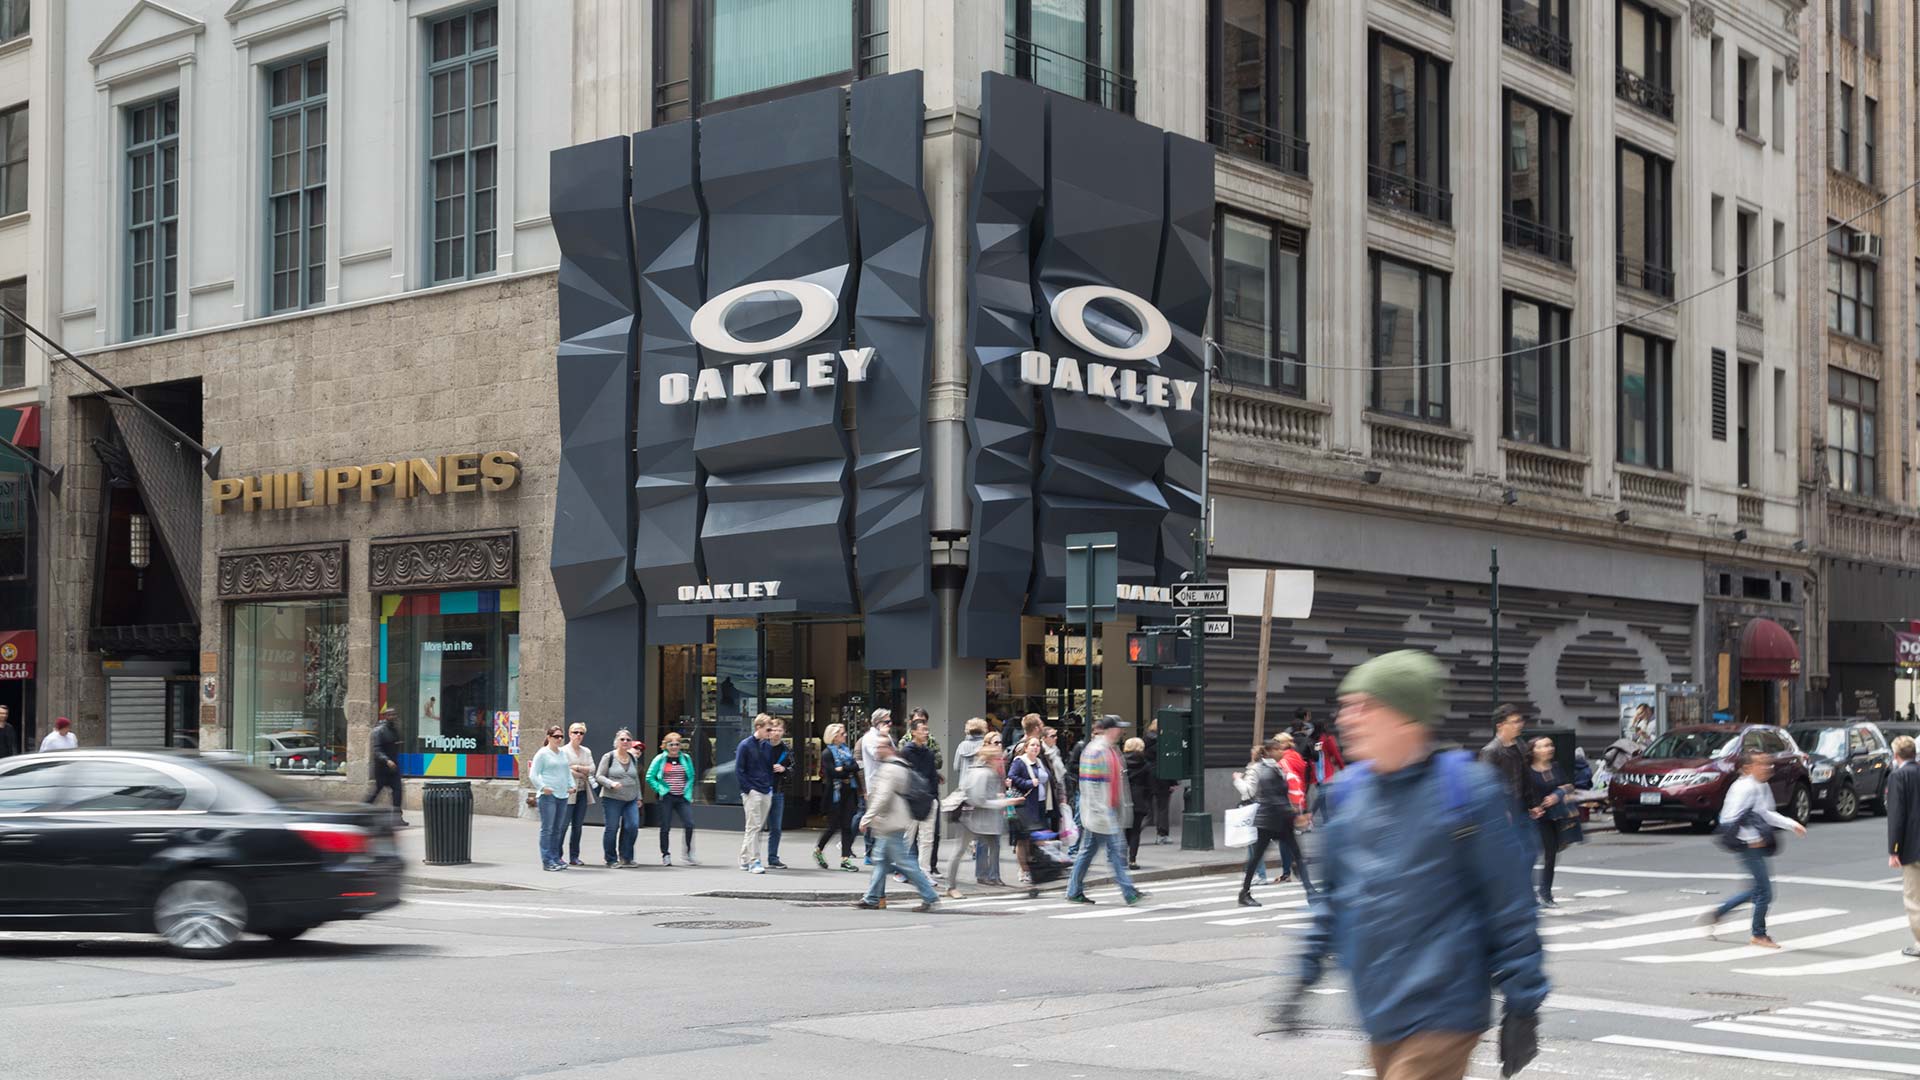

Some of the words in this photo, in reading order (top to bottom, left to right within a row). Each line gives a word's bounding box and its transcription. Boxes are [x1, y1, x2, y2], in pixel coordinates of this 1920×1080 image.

[659, 347, 875, 404] OAKLEY
[1021, 351, 1198, 410] OAKLEY
[212, 451, 520, 514] PHILIPPINES
[678, 581, 781, 600] OAKLEY
[1117, 584, 1172, 602] OAKL
[1180, 591, 1197, 601] ONE
[1204, 591, 1221, 601] WAY
[1208, 623, 1226, 631] WAY
[424, 641, 442, 652] More
[442, 641, 453, 651] fun
[454, 641, 461, 651] in
[461, 641, 473, 651] the
[425, 736, 476, 751] Philippines
